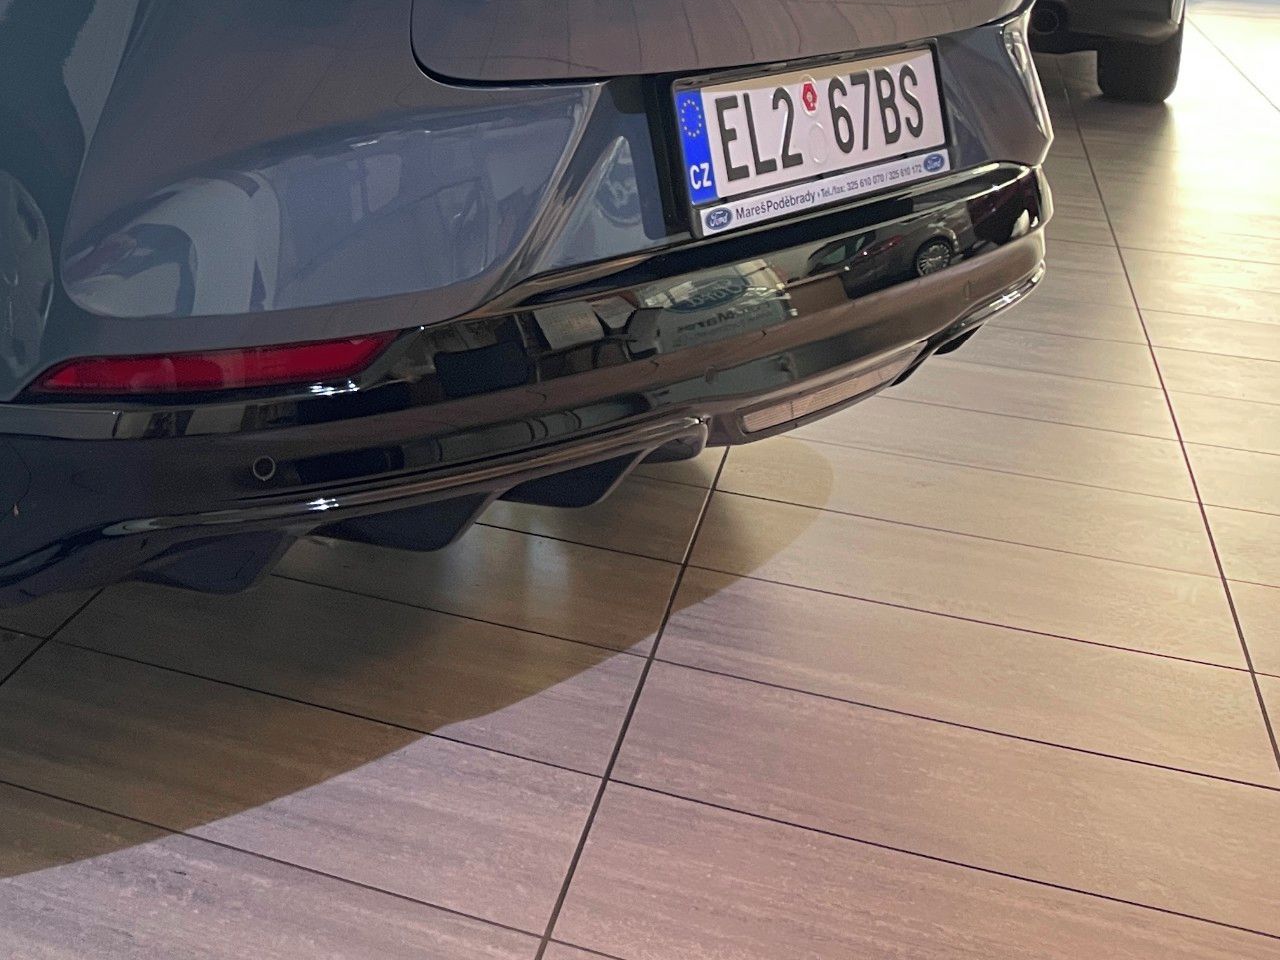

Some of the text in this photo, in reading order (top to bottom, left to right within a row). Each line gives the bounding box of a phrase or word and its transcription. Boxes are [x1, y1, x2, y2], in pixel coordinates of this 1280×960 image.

[715, 64, 924, 182] EL2 67BS
[690, 162, 712, 190] CZ
